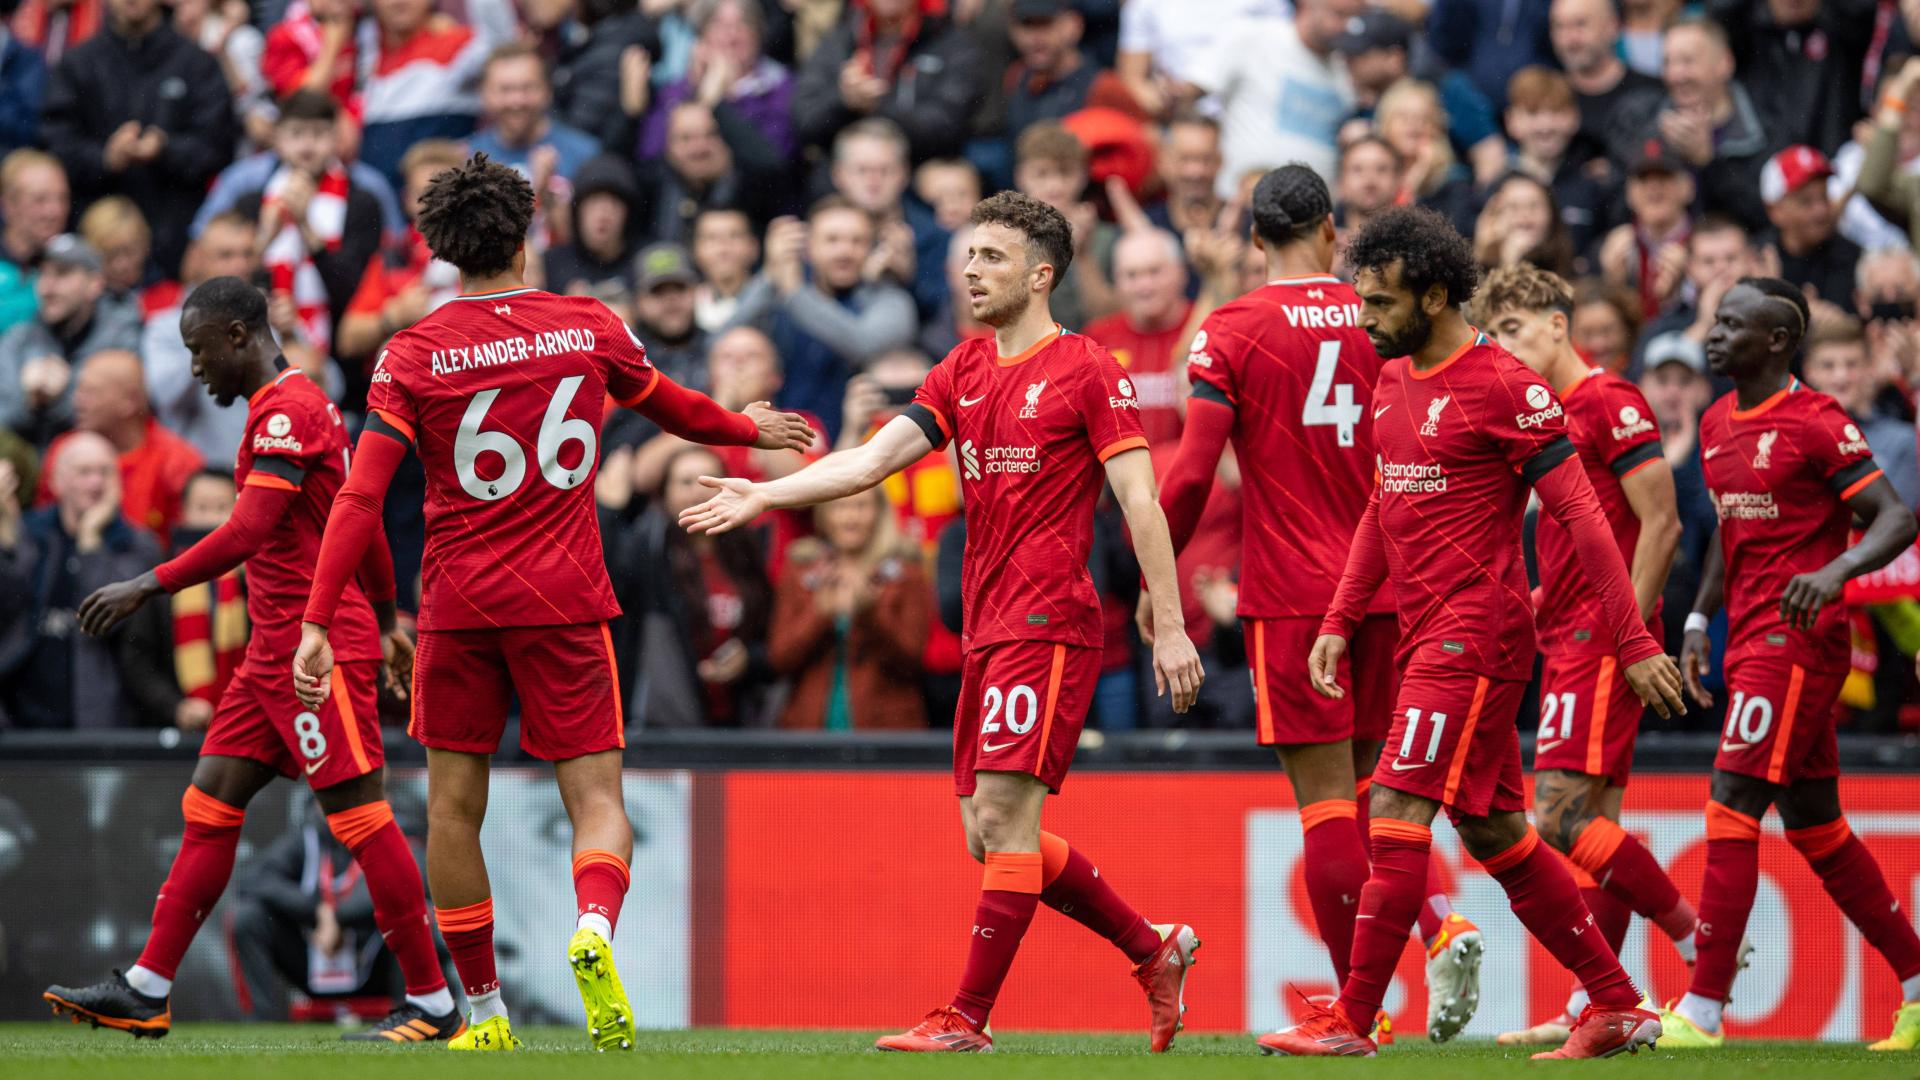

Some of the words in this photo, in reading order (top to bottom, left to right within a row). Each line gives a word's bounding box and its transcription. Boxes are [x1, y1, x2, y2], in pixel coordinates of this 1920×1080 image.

[371, 368, 392, 383] edia
[431, 328, 596, 376] ALEXANDER-ARNOLD
[1302, 340, 1364, 448] 4
[1515, 401, 1563, 430] Expedi
[454, 374, 597, 501] 66
[985, 458, 1041, 474] cartered
[1384, 461, 1441, 478] standard
[1384, 476, 1447, 493] chartered
[981, 684, 1038, 735] 20
[1537, 691, 1577, 740] 21
[1725, 690, 1773, 744] 10
[293, 711, 327, 760] 8
[1399, 706, 1448, 764] 11
[972, 925, 995, 938] FC
